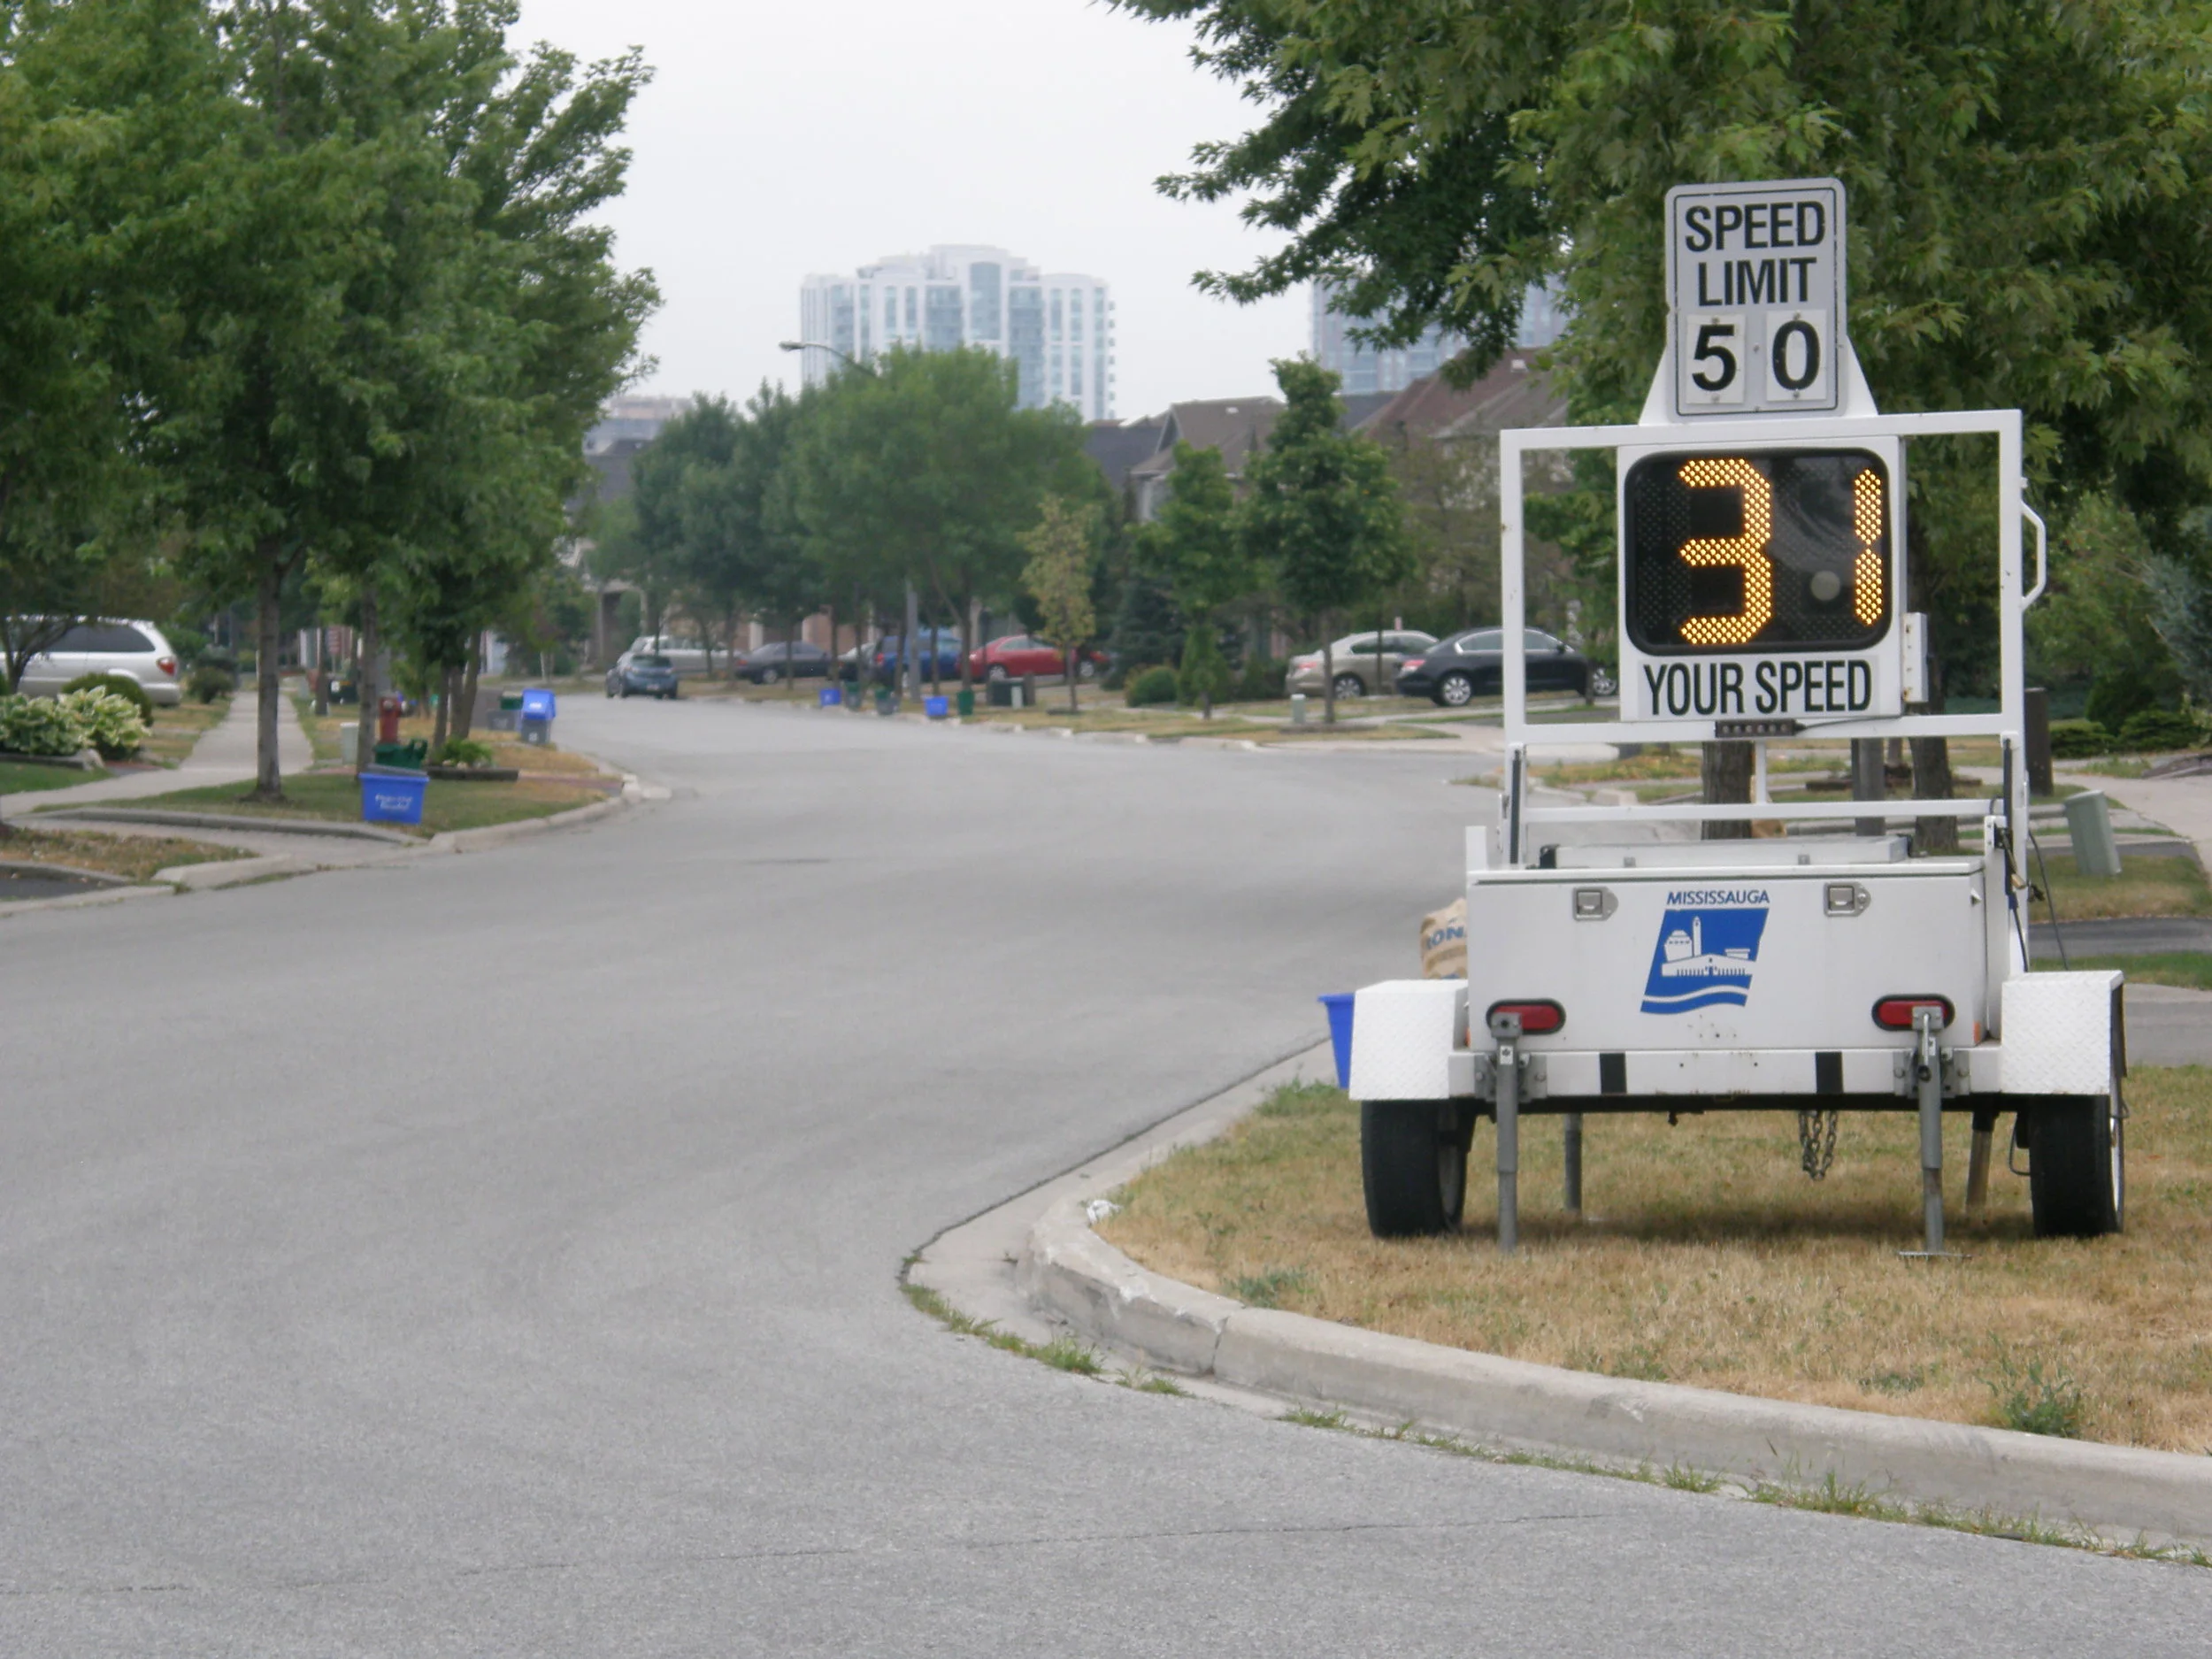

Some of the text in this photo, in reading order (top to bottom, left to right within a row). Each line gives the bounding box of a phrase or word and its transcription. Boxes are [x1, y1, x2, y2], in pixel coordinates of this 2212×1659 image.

[1685, 200, 1825, 252] SPEED
[1698, 257, 1817, 306] LIMIT
[1691, 320, 1821, 392] 50
[1678, 457, 1884, 645] 31
[1643, 659, 1872, 717] YOUR SPEED
[1666, 889, 1770, 905] MISSISSAUGA
